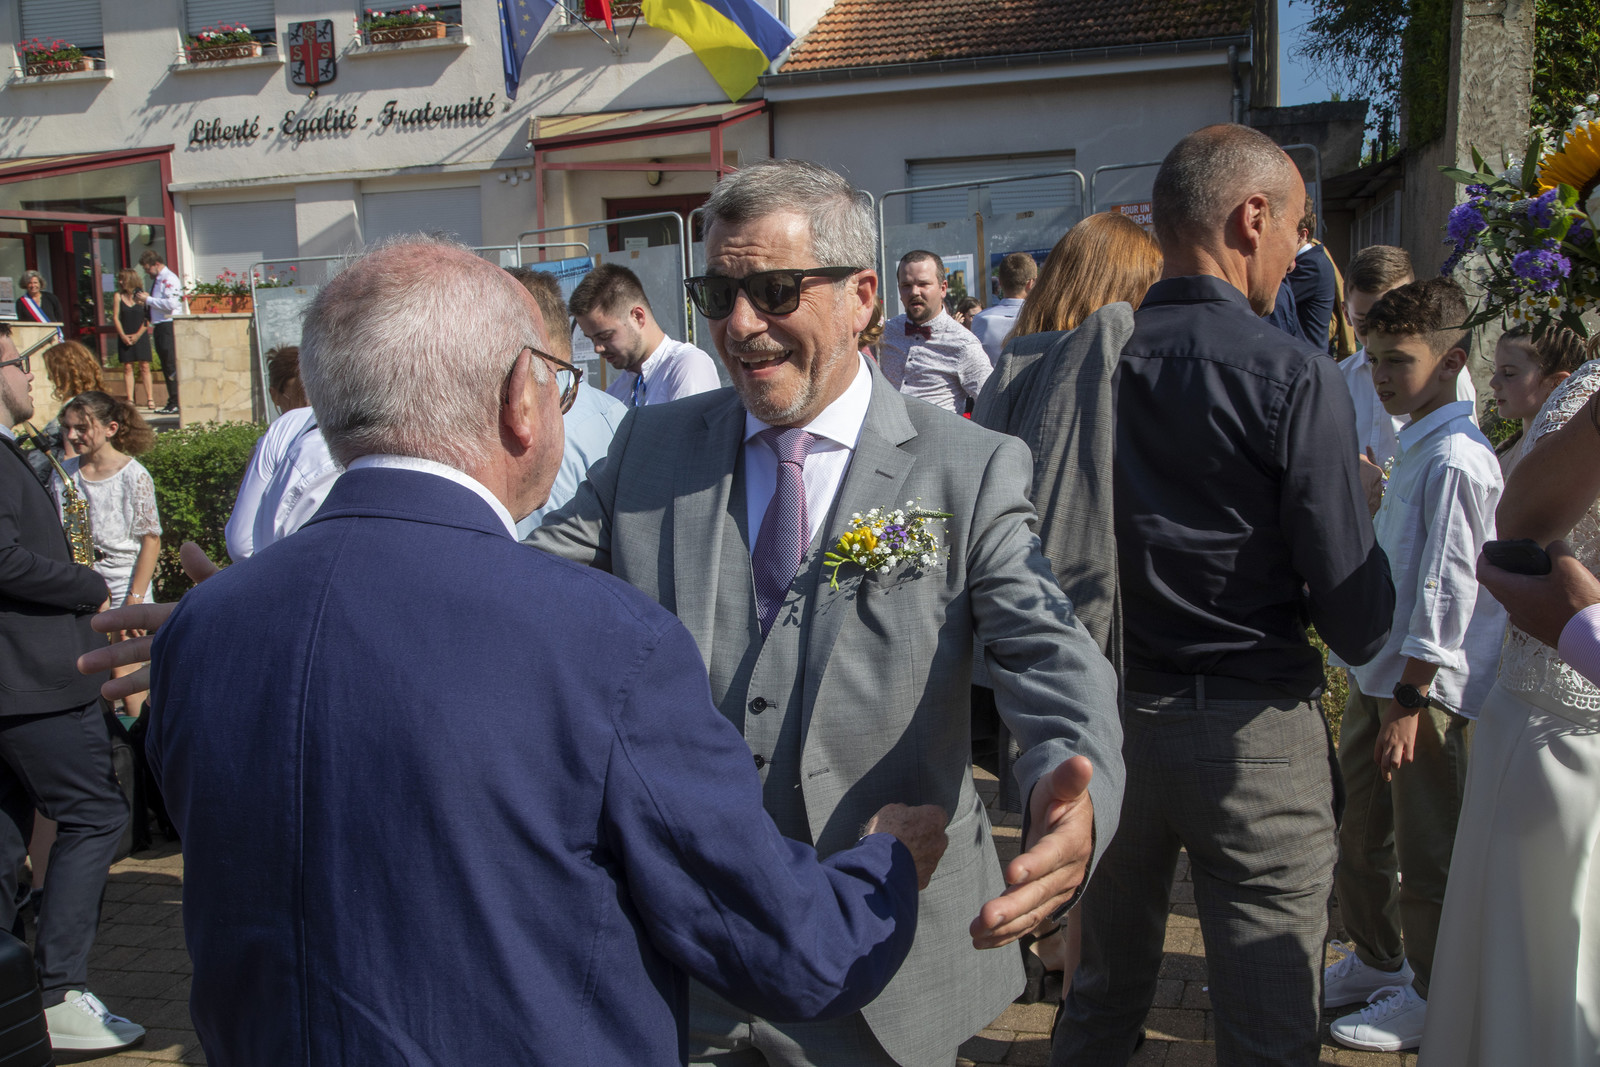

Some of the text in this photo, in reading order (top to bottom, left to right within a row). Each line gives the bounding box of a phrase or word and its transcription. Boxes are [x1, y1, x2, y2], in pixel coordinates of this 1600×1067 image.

[293, 43, 331, 61] S S
[190, 115, 261, 145] Liberté
[282, 105, 359, 143] Egalité
[381, 93, 496, 128] Fraternité
[1120, 203, 1150, 215] POUR UN
